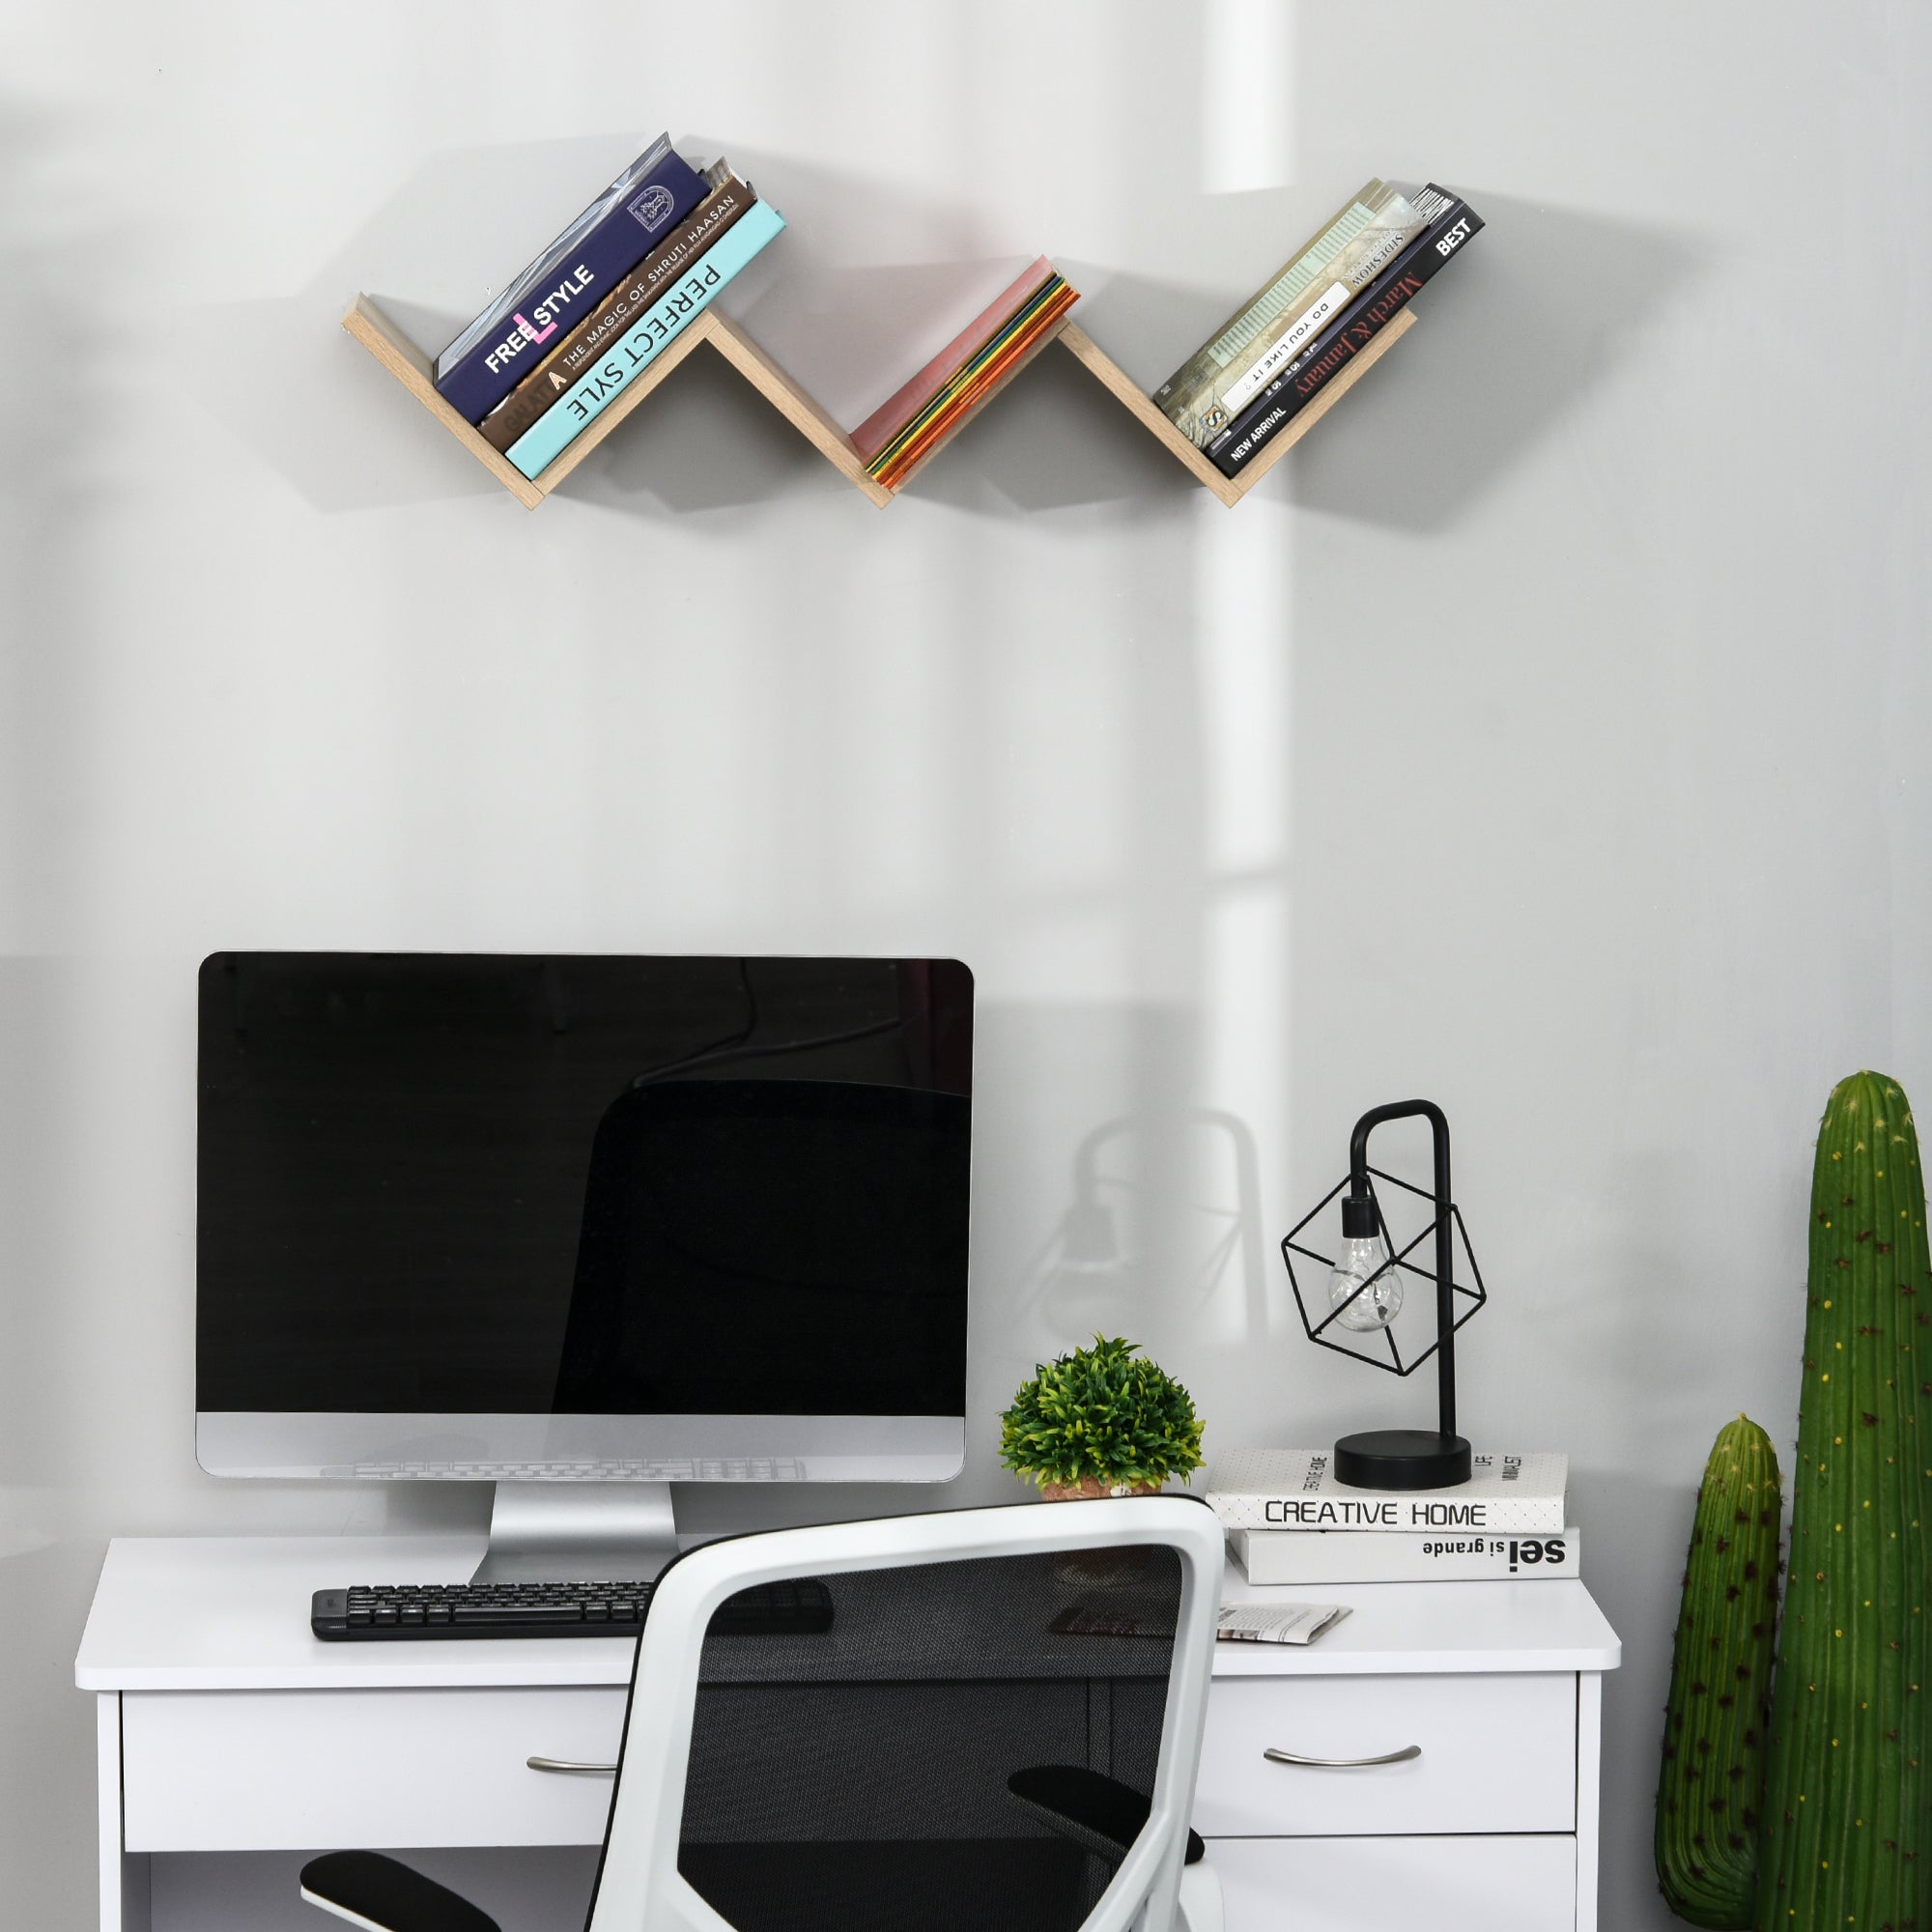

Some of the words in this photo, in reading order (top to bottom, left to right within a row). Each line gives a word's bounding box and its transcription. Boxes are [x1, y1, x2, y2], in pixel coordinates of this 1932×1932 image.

[1435, 217, 1471, 257] BEST
[1352, 236, 1403, 287] SIDESHOW
[563, 345, 585, 365] THE
[587, 303, 626, 343] MAGIC
[630, 283, 644, 300] OF
[648, 243, 686, 281] SHRUTI
[688, 196, 733, 242] HAASAN
[1368, 271, 1423, 324] March
[485, 321, 538, 373] FREE
[534, 265, 594, 325] STYLE
[625, 265, 721, 367] PERFECT
[1313, 303, 1328, 319] DO
[1290, 323, 1311, 344] YOU
[1352, 322, 1371, 338] &
[1264, 344, 1288, 368] LIKE
[1296, 333, 1358, 396] January
[567, 363, 623, 420] SYLE
[1253, 370, 1263, 381] IT
[1232, 439, 1252, 461] NEW
[1251, 408, 1286, 442] ARRIVAL
[1265, 1500, 1397, 1525] CREATIVE
[1412, 1502, 1486, 1526] HOME
[1423, 1538, 1485, 1557] grande
[1491, 1541, 1505, 1556] si
[1509, 1539, 1566, 1573] sei
